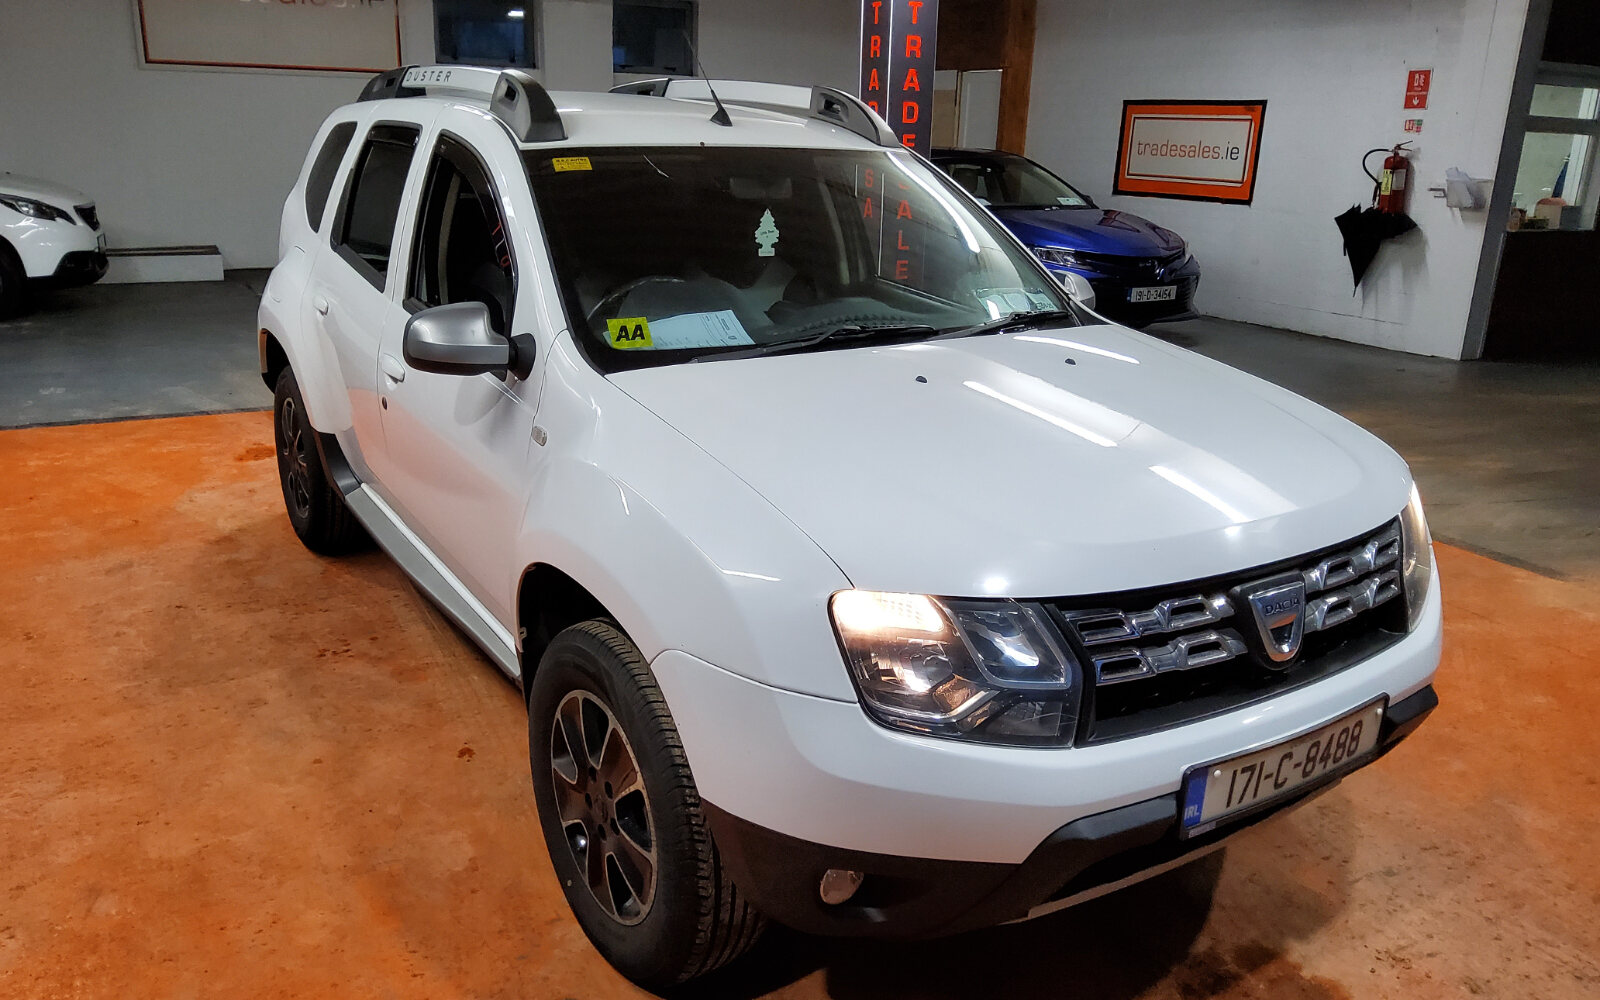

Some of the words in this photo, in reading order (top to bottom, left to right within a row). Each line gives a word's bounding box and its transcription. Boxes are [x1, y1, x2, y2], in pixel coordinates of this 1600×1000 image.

[406, 70, 452, 82] DUSTER
[1137, 139, 1240, 161] tradesales.ie
[895, 182, 912, 280] ALE
[1135, 289, 1172, 301] 191-D-34154
[615, 324, 646, 342] AA
[1265, 597, 1300, 616] DACIA
[1226, 719, 1363, 808] 171-C-8488
[1184, 804, 1200, 820] IRL
